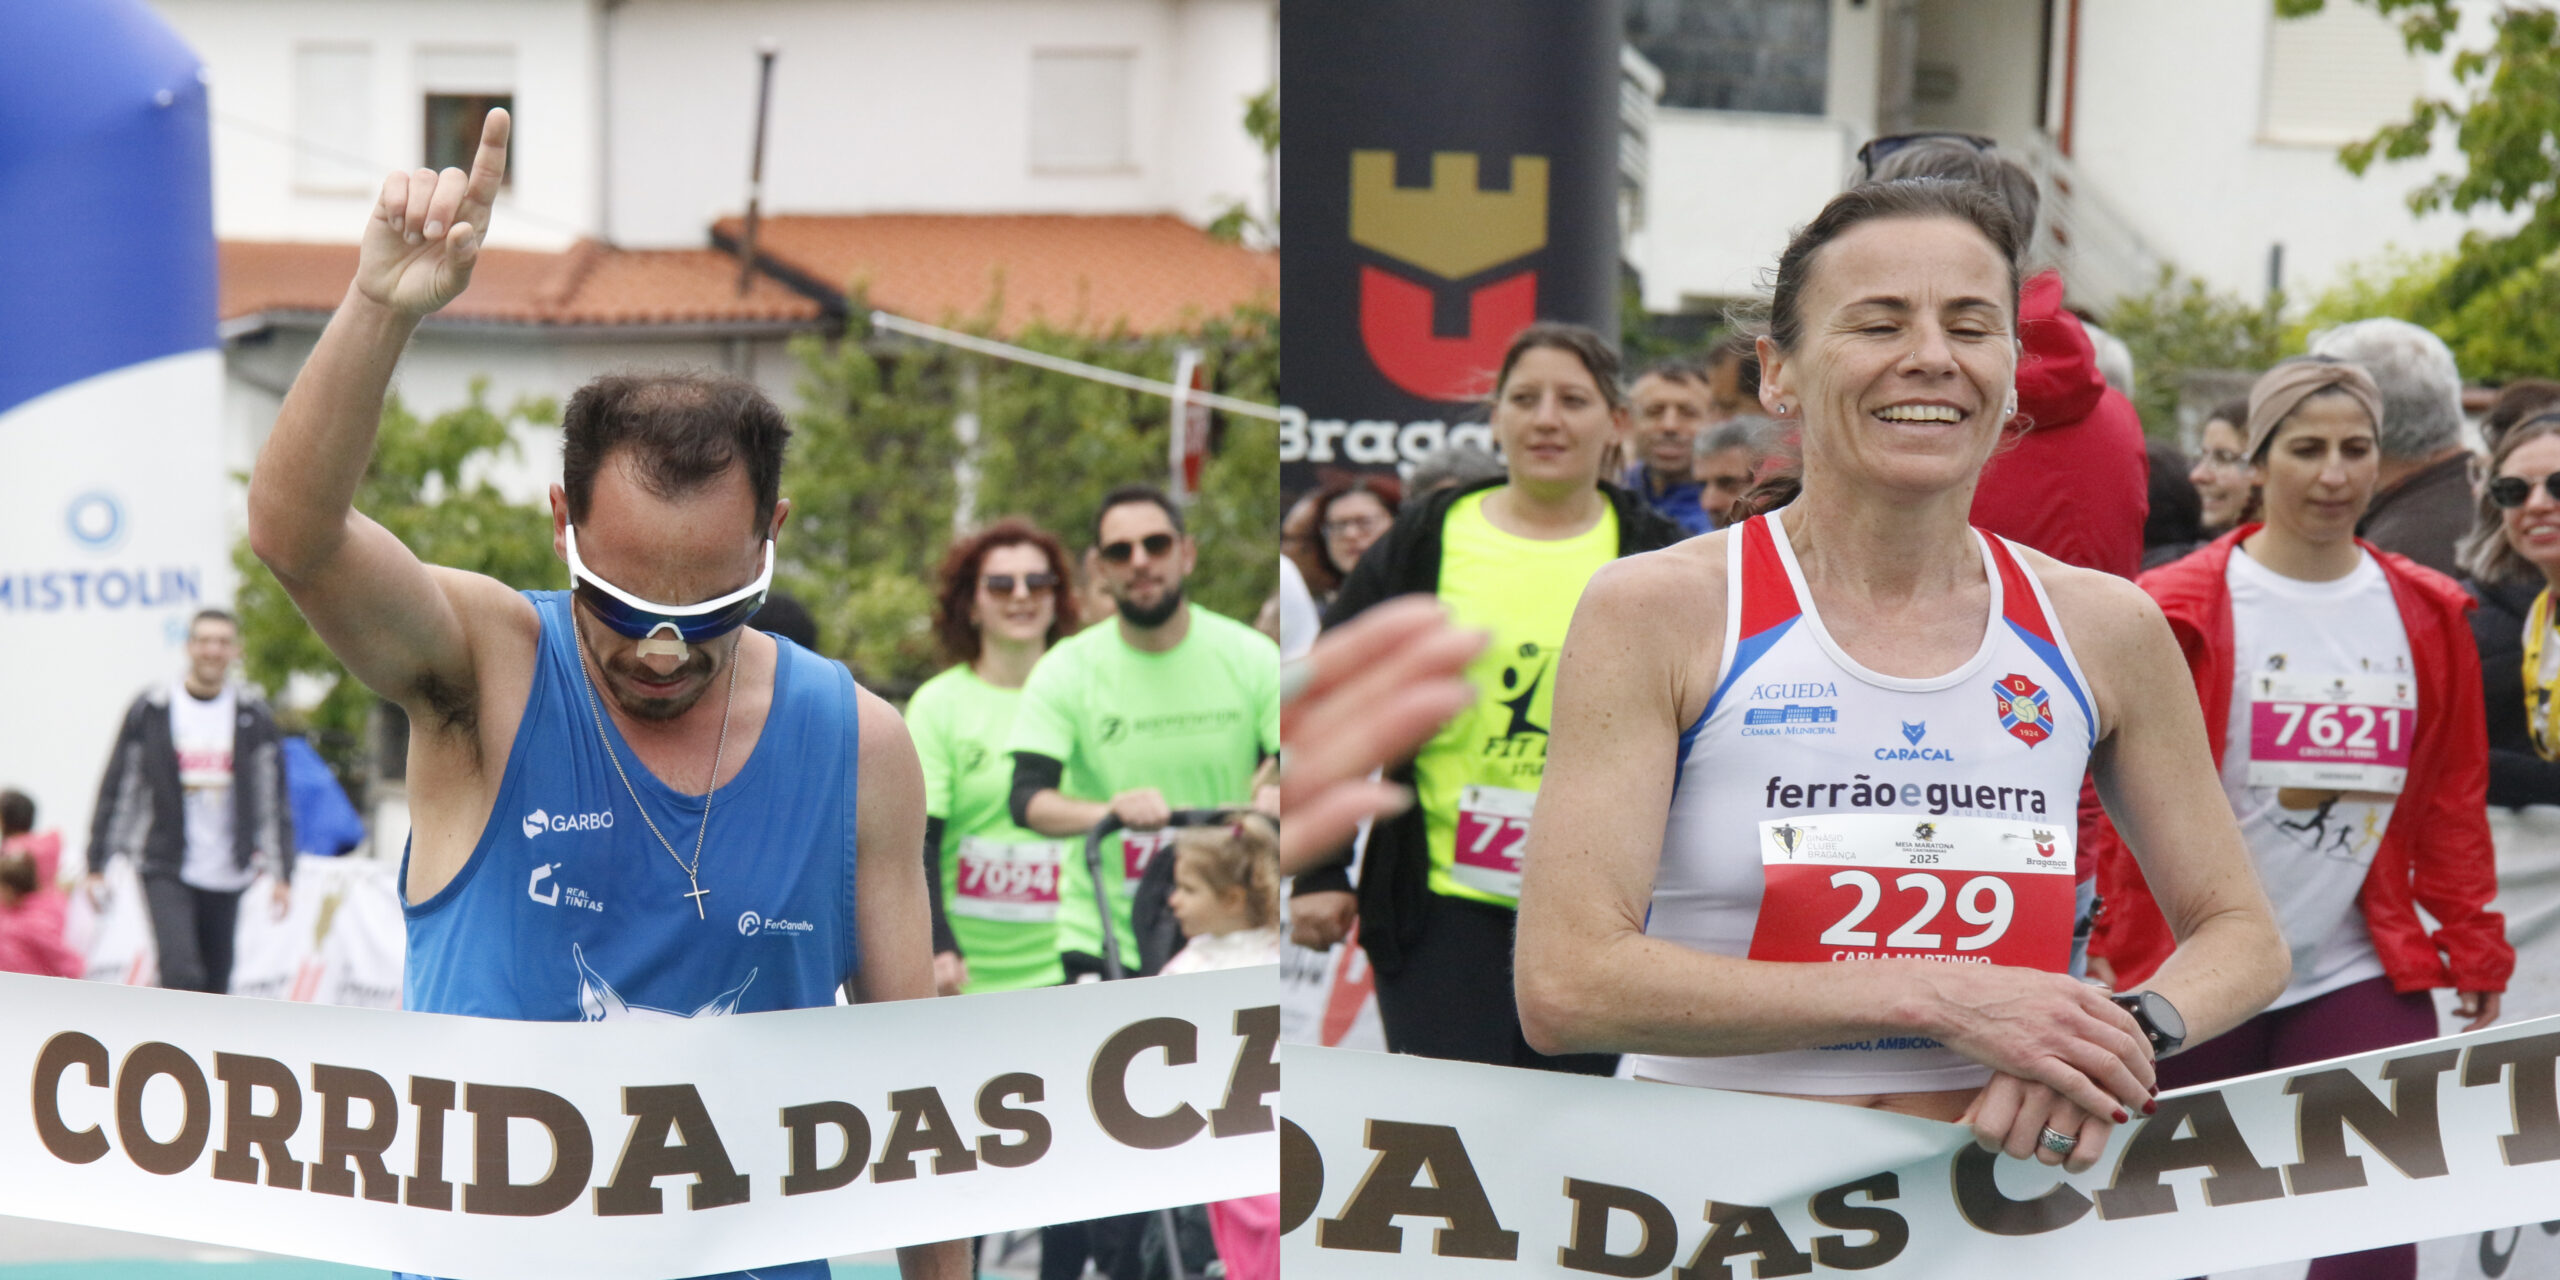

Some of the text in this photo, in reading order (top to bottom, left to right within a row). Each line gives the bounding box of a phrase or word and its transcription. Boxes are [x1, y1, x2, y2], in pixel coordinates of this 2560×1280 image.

[1280, 405, 1508, 481] Braga
[2020, 729, 2039, 738] 1924
[2272, 703, 2400, 752] 7621
[1874, 748, 1954, 761] CARACAL
[551, 811, 614, 832] GARBO
[1909, 854, 1939, 864] 2025
[2026, 858, 2067, 868] Bragança
[965, 857, 1054, 896] 7094
[566, 887, 590, 899] REAL
[565, 896, 604, 912] TINTAS
[1819, 869, 2015, 951] 229
[30, 1030, 751, 1218] CORRIDA
[779, 1072, 1053, 1198] DAS
[1557, 1170, 1909, 1280] DAS
